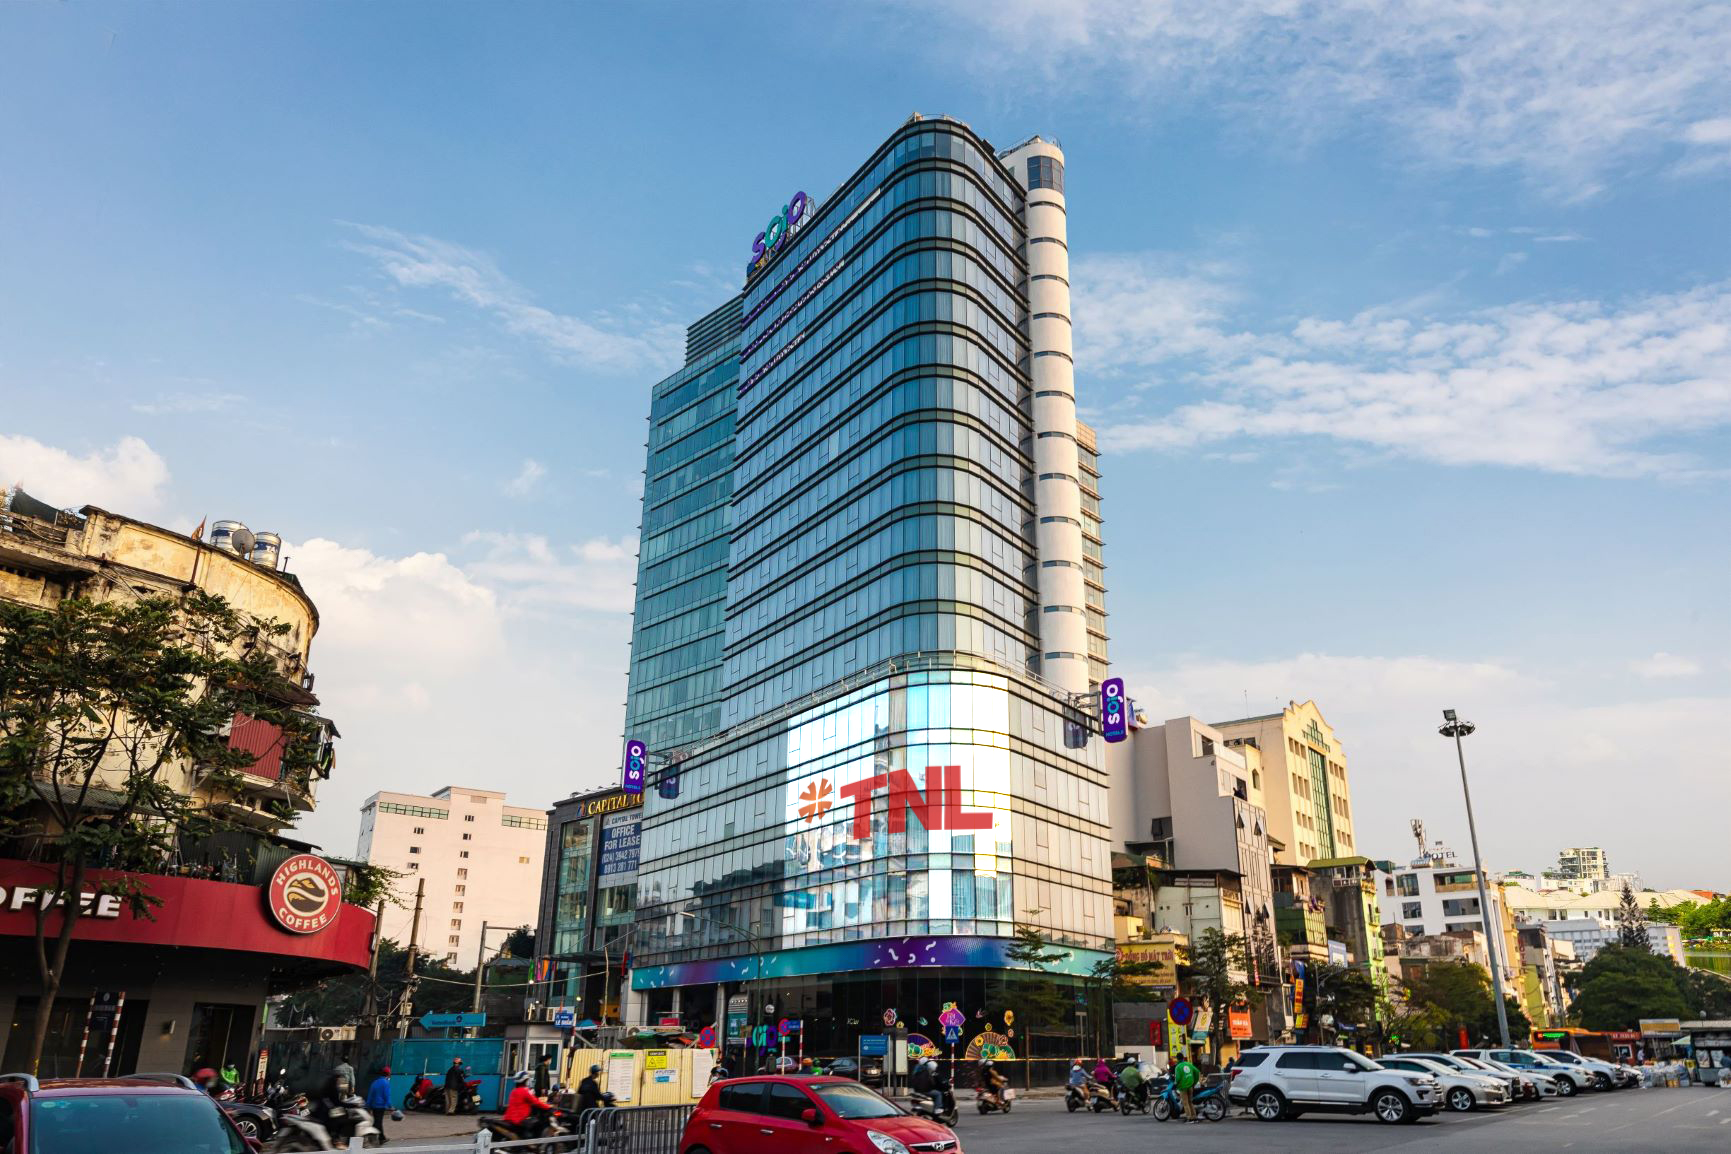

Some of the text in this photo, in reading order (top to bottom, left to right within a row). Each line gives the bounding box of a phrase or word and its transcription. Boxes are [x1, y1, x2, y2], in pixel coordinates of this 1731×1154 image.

[1106, 684, 1123, 725] sojo
[629, 745, 645, 780] sojo
[588, 793, 628, 815] CAPITAL
[840, 765, 993, 840] TNL
[604, 836, 641, 851] FOR LEASE
[612, 824, 635, 838] OFFICE
[276, 859, 338, 895] HIGHLANDS
[0, 886, 122, 917] FFEE
[279, 907, 327, 929] COFFEE
